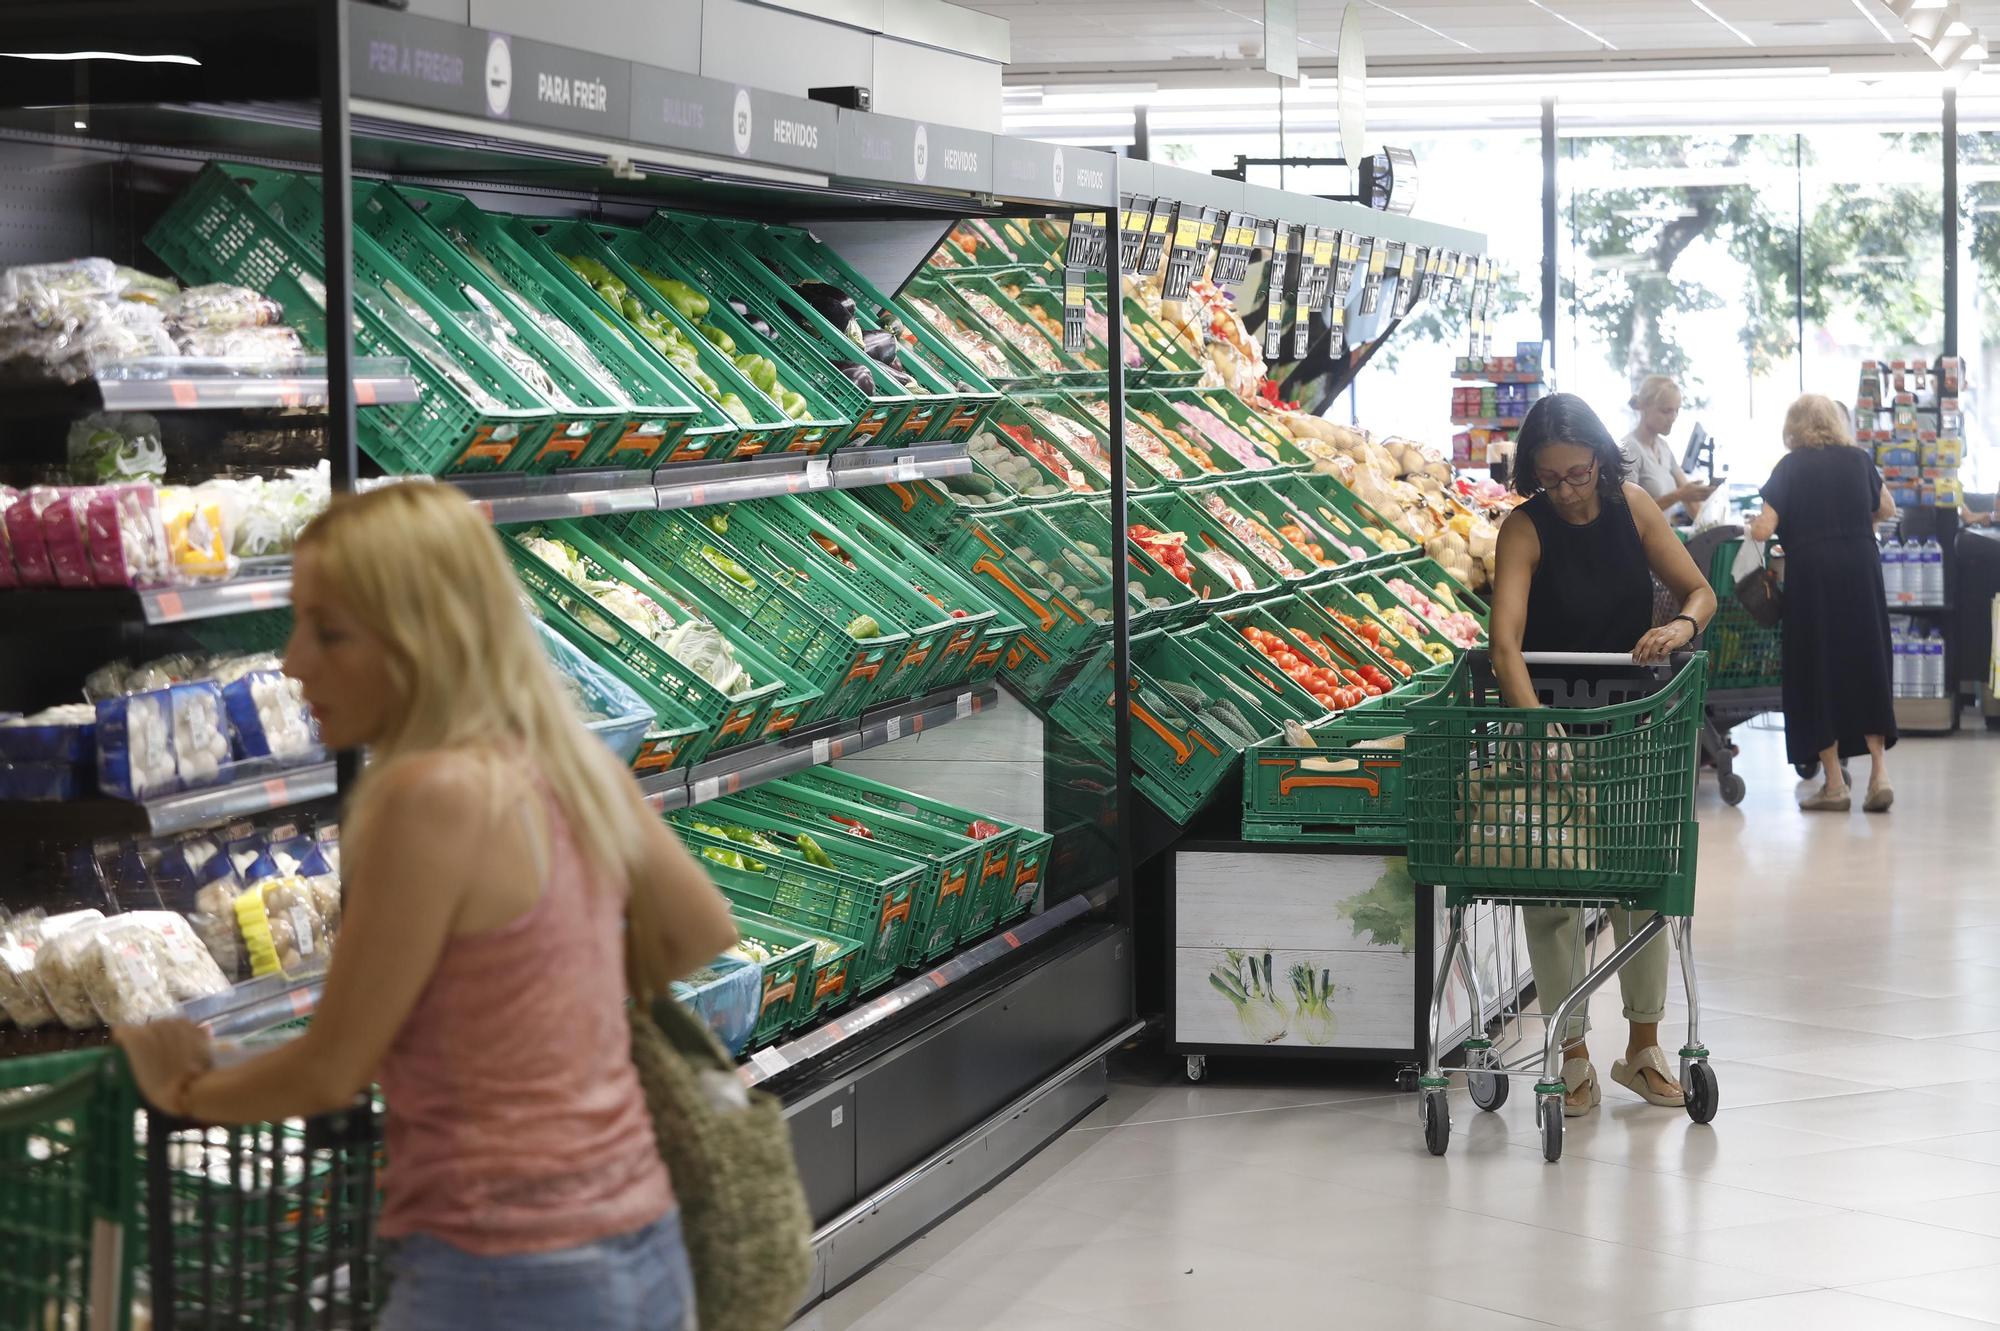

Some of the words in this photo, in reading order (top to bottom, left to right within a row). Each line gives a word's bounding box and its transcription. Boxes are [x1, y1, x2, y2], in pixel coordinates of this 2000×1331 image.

[538, 72, 571, 107] PARA
[573, 76, 607, 112] FREÍR
[774, 119, 818, 149] HERVIDOS
[944, 149, 977, 172] HERVIDOS
[1076, 167, 1104, 190] HERVIDOS
